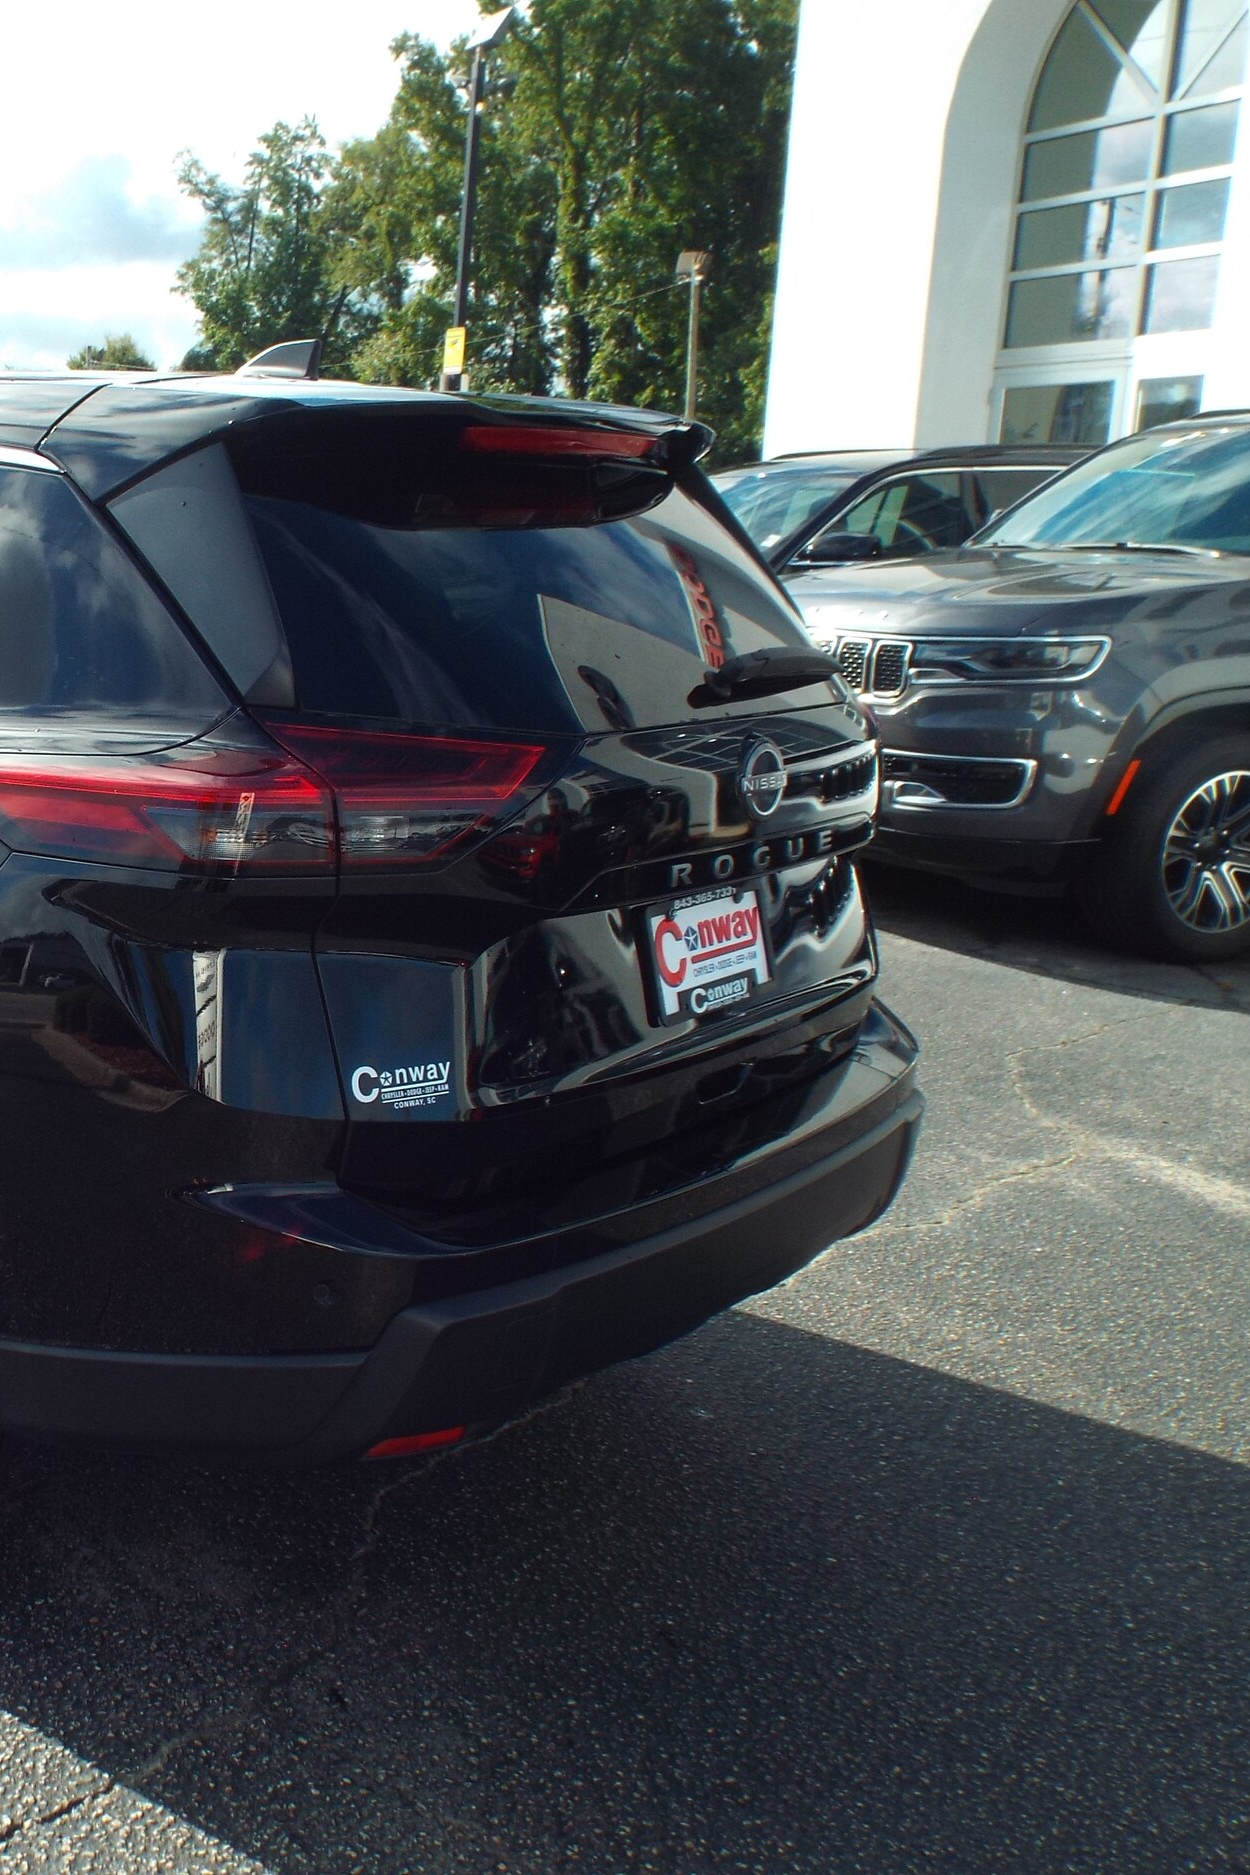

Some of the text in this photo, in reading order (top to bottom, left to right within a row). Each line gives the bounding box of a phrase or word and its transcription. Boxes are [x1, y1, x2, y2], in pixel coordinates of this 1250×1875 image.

[671, 831, 832, 887] ROGUE
[654, 905, 760, 988] Conway
[689, 976, 748, 1014] Conway
[352, 1061, 450, 1103] Conway
[381, 1083, 449, 1100] CHRYSLER DODGE JEEP RAM
